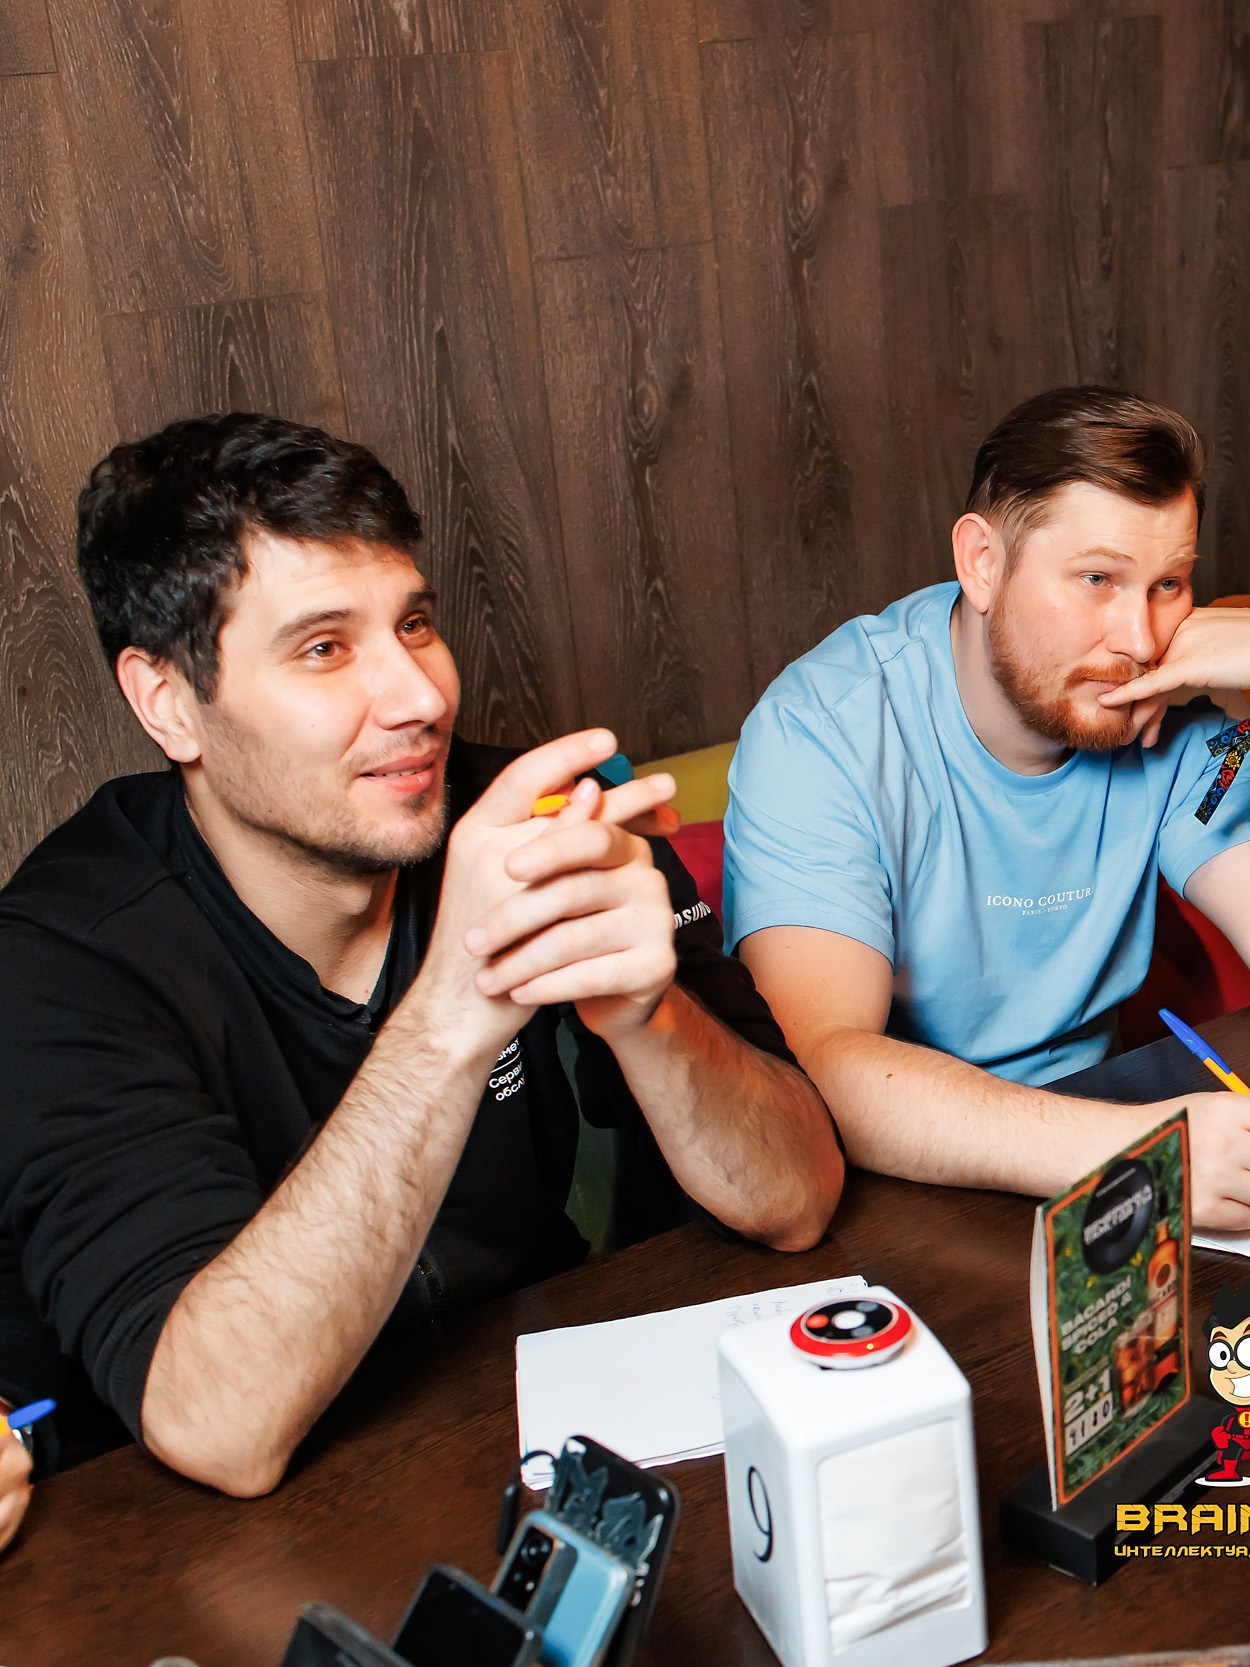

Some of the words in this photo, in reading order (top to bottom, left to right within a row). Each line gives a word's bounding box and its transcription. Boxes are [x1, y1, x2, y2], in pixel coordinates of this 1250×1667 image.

[986, 895, 1034, 908] ICONO
[1061, 1275, 1131, 1337] BACARDI
[1074, 1317, 1118, 1355] COLA
[1065, 1368, 1112, 1423] 2+1
[746, 1465, 774, 1564] 9
